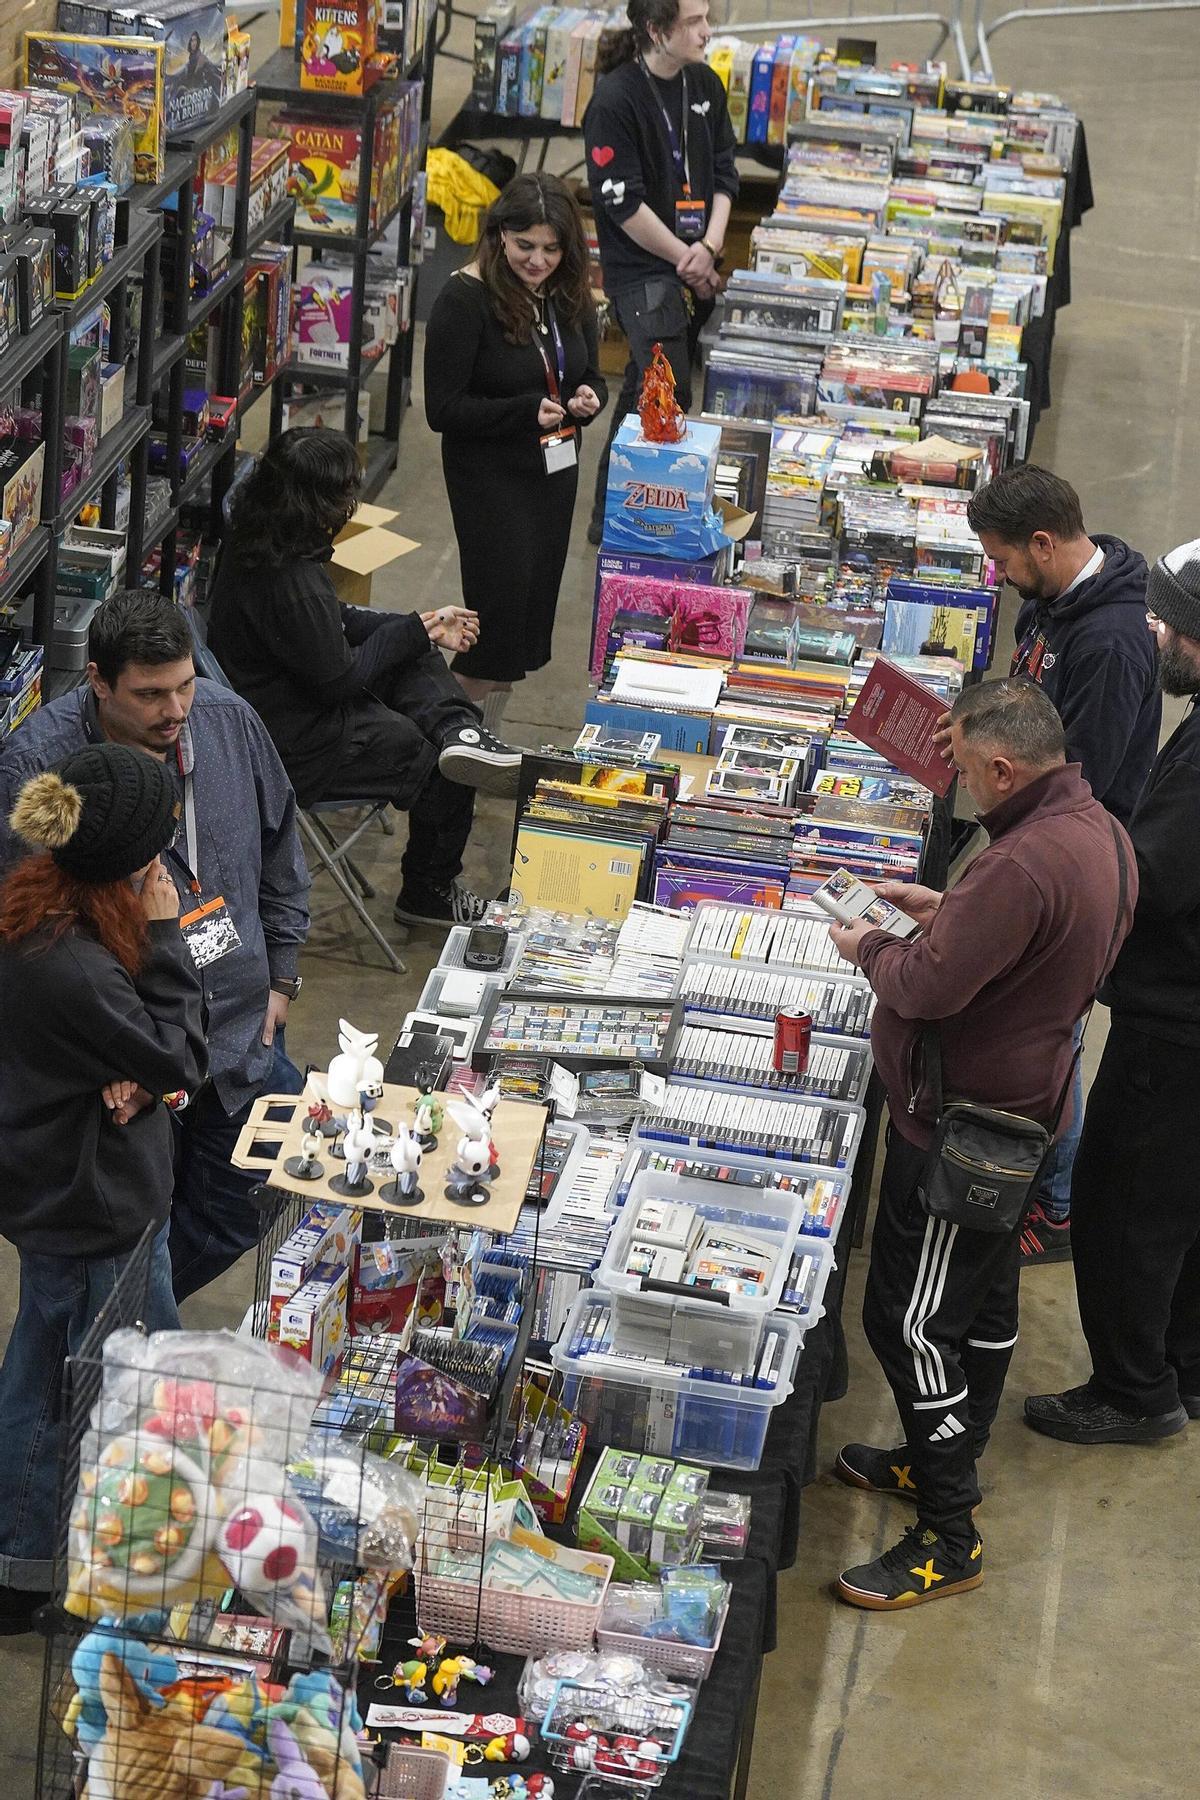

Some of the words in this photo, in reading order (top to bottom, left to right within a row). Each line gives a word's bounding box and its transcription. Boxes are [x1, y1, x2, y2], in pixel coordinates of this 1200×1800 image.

[315, 7, 358, 26] KITTENS
[33, 73, 68, 82] ACADEMY
[169, 91, 202, 112] NACIDOS
[201, 85, 214, 97] DE
[171, 107, 182, 121] LA
[181, 99, 210, 118] BRUMA
[295, 129, 343, 151] CATAN
[309, 348, 342, 362] FORTNITE
[623, 480, 690, 512] ZELDA
[272, 1228, 322, 1265] MEGA
[282, 1280, 333, 1314] MEGA
